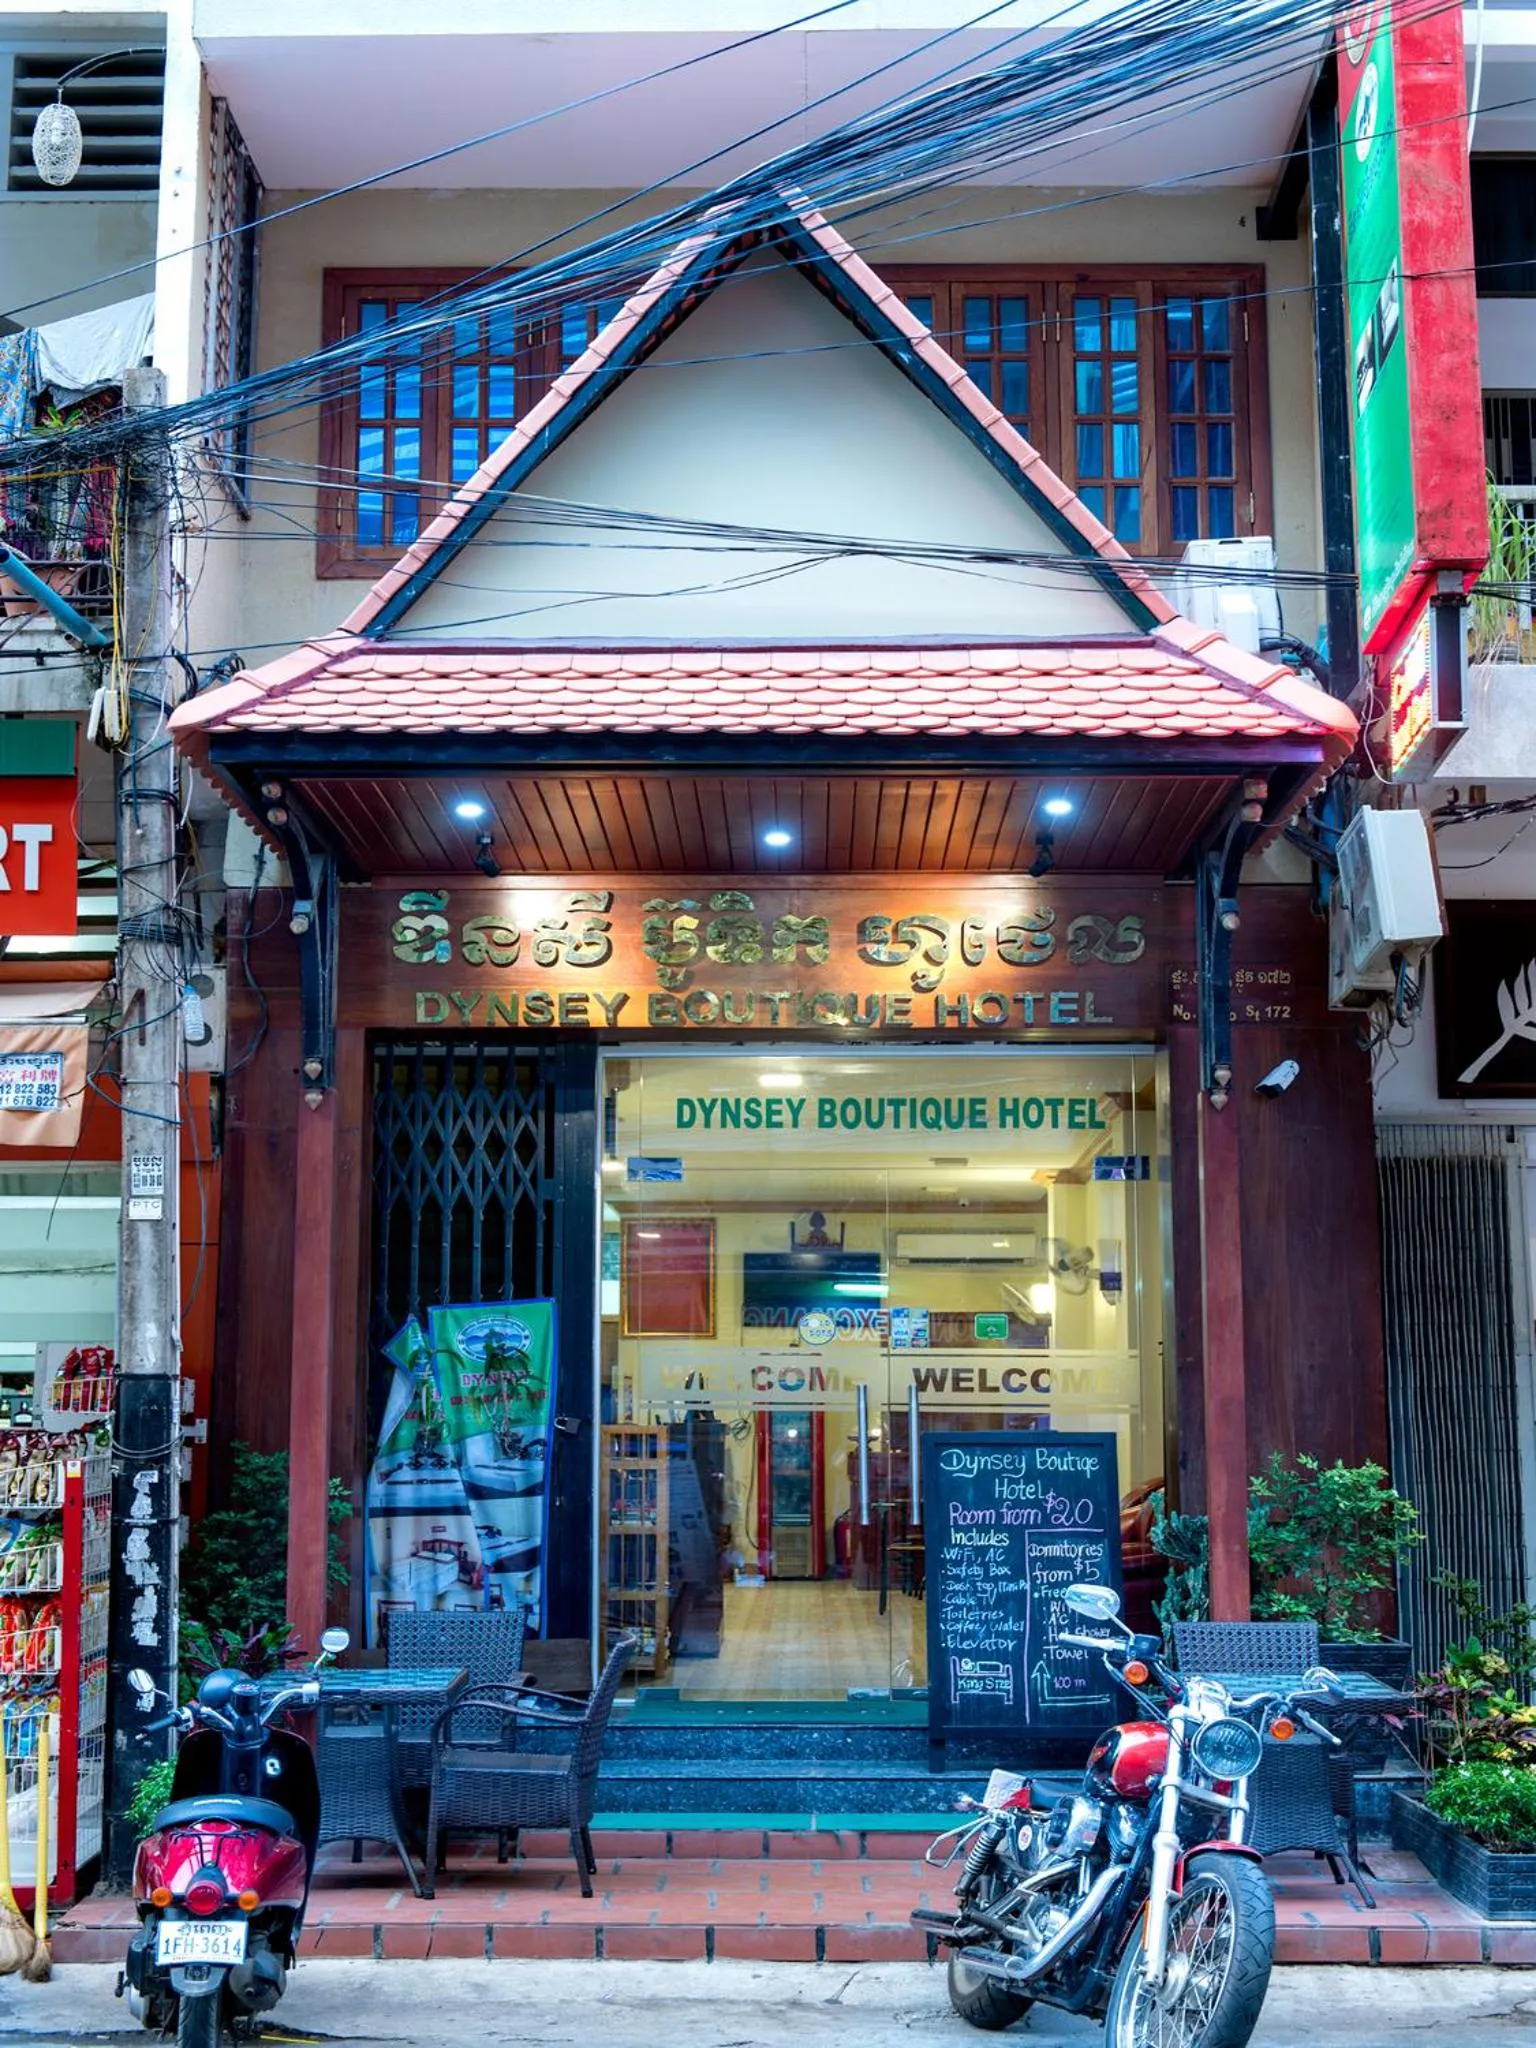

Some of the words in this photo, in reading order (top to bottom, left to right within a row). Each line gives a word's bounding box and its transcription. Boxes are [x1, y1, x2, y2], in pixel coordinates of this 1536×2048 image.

[415, 991, 629, 1026] DYNSEY
[648, 990, 914, 1026] BOUTIQUE
[936, 991, 1113, 1025] HOTEL
[1245, 1005, 1260, 1021] St
[1265, 1006, 1291, 1018] 172
[15, 1084, 34, 1095] 822
[37, 1084, 57, 1096] 583
[676, 1097, 806, 1130] DYNSEY
[818, 1097, 988, 1132] BOUTIQUE
[999, 1097, 1107, 1130] HOTEL
[940, 1449, 1026, 1478] Dynsey
[1036, 1448, 1100, 1479] Boutiqe
[995, 1478, 1045, 1500] Hotel
[950, 1501, 996, 1526] Room
[1000, 1501, 1042, 1525] from
[1043, 1488, 1093, 1526] $20
[951, 1527, 1010, 1547] Includes
[947, 1562, 984, 1580] Safety
[989, 1563, 1012, 1577] Box
[1033, 1562, 1073, 1585] from
[1074, 1557, 1101, 1582] $5
[1041, 1586, 1067, 1599] Free
[943, 1606, 1005, 1621] Toiletries
[947, 1633, 1017, 1652] Elevator
[1049, 1625, 1069, 1643] Ht
[1043, 1645, 1089, 1660] Towel
[957, 1677, 984, 1692] King
